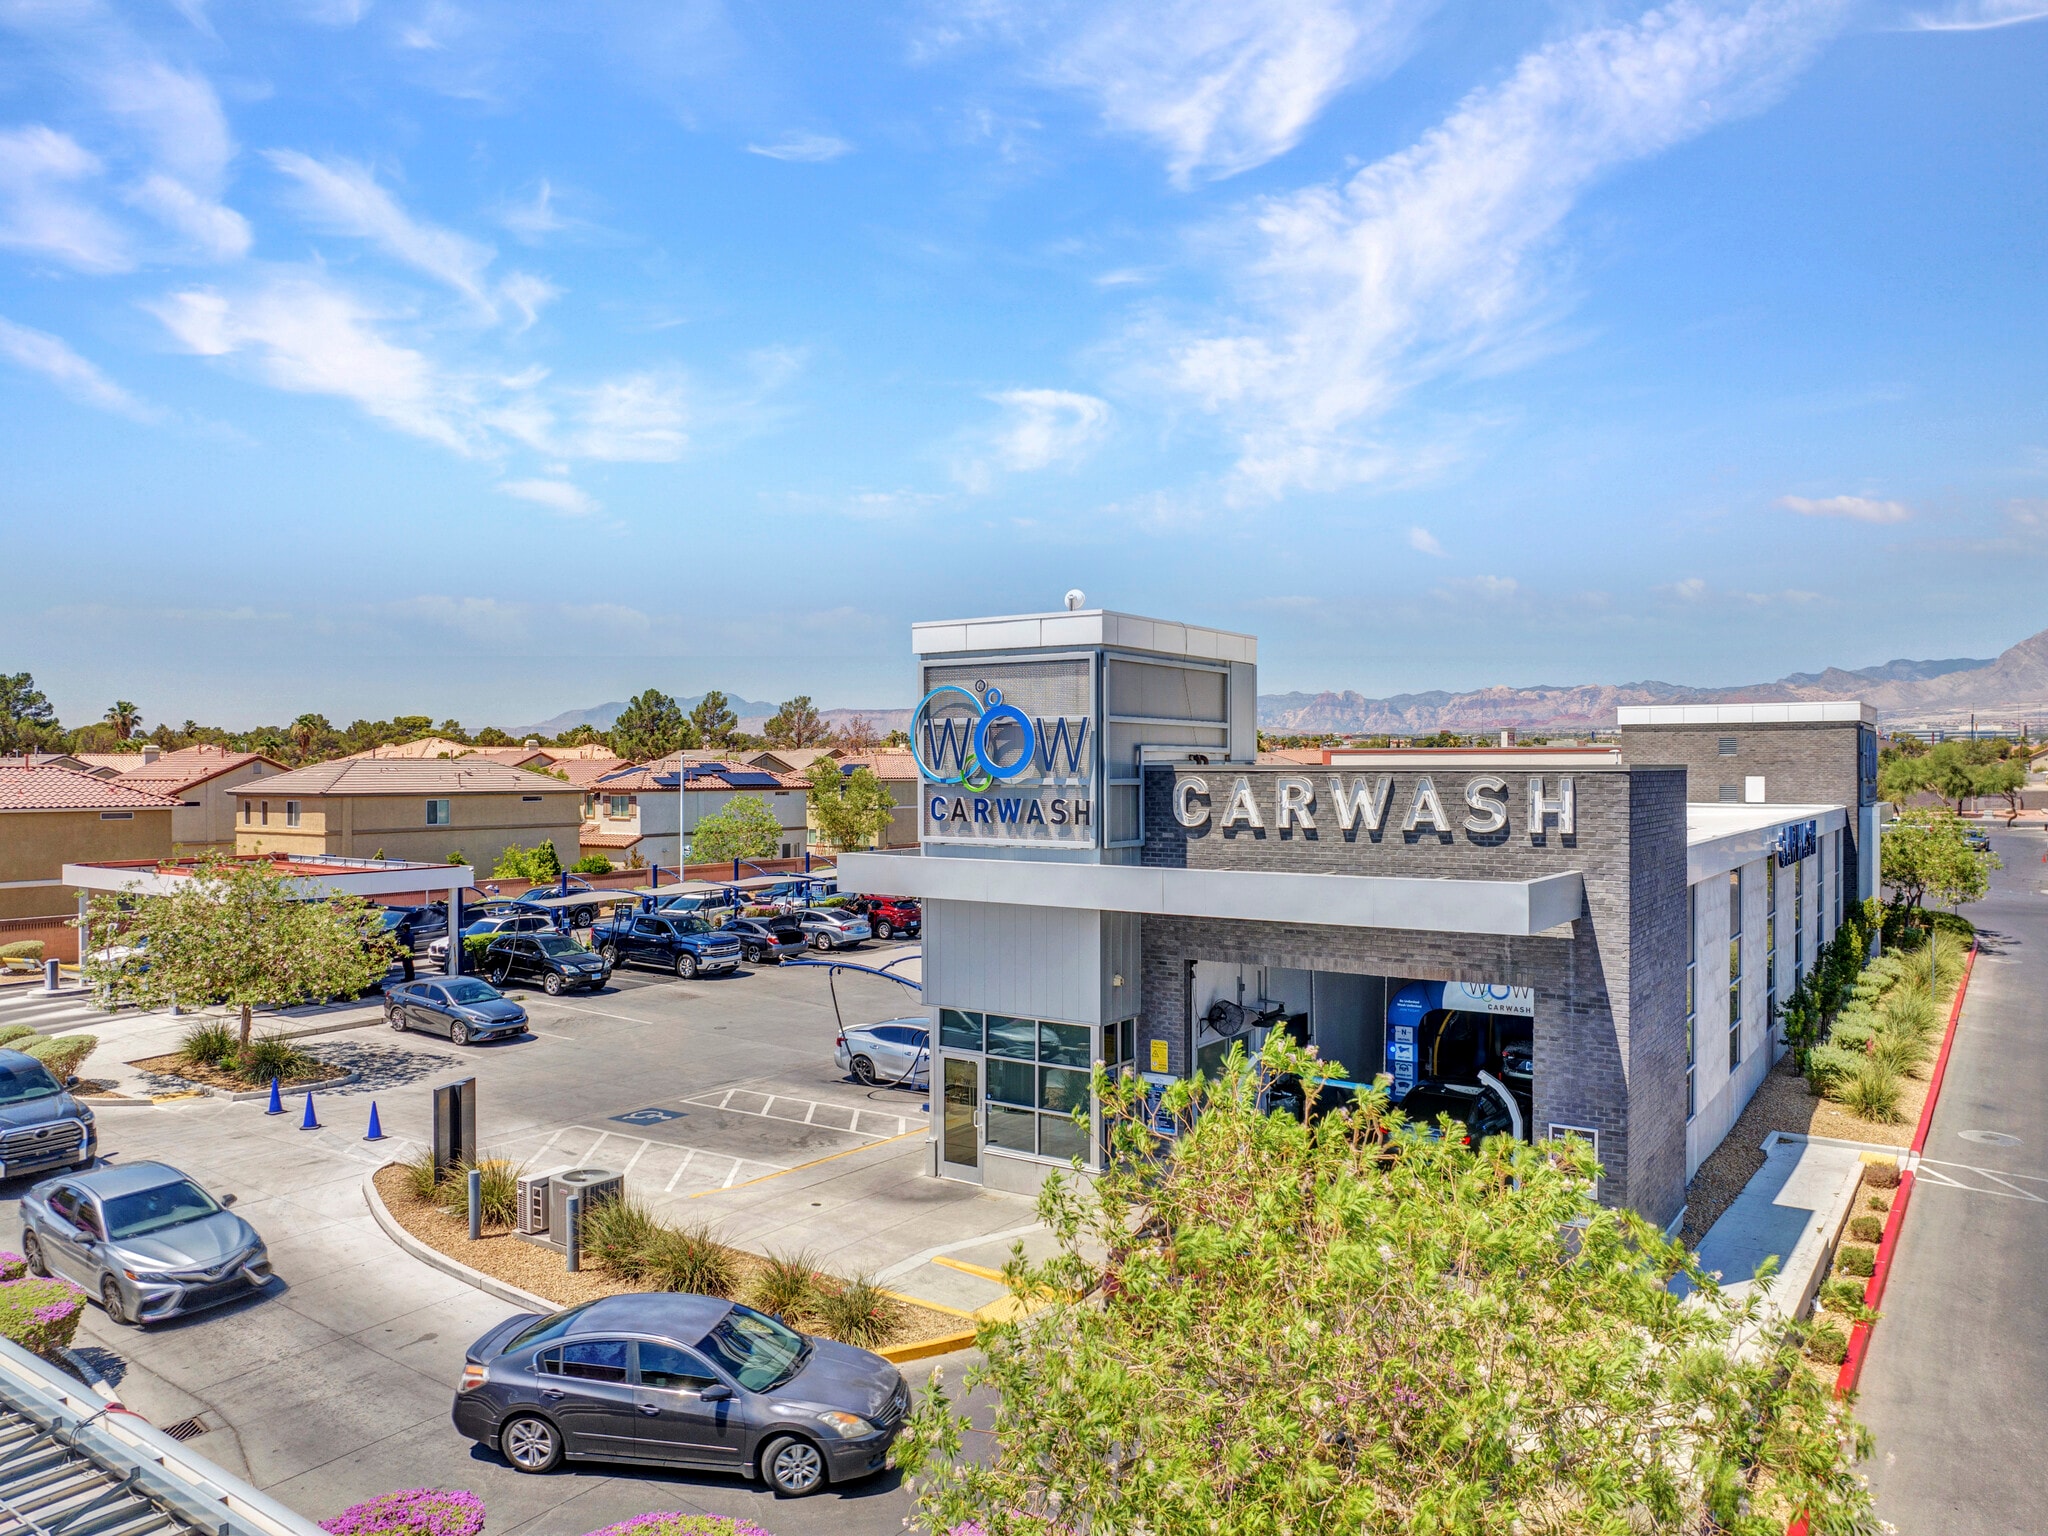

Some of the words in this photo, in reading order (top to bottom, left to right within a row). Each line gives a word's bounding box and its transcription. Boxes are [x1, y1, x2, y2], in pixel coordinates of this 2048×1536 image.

[927, 704, 1090, 779] WOW
[931, 795, 1094, 826] CARWASH
[1172, 774, 1575, 834] CARWASH
[1487, 1003, 1531, 1014] CARWASH
